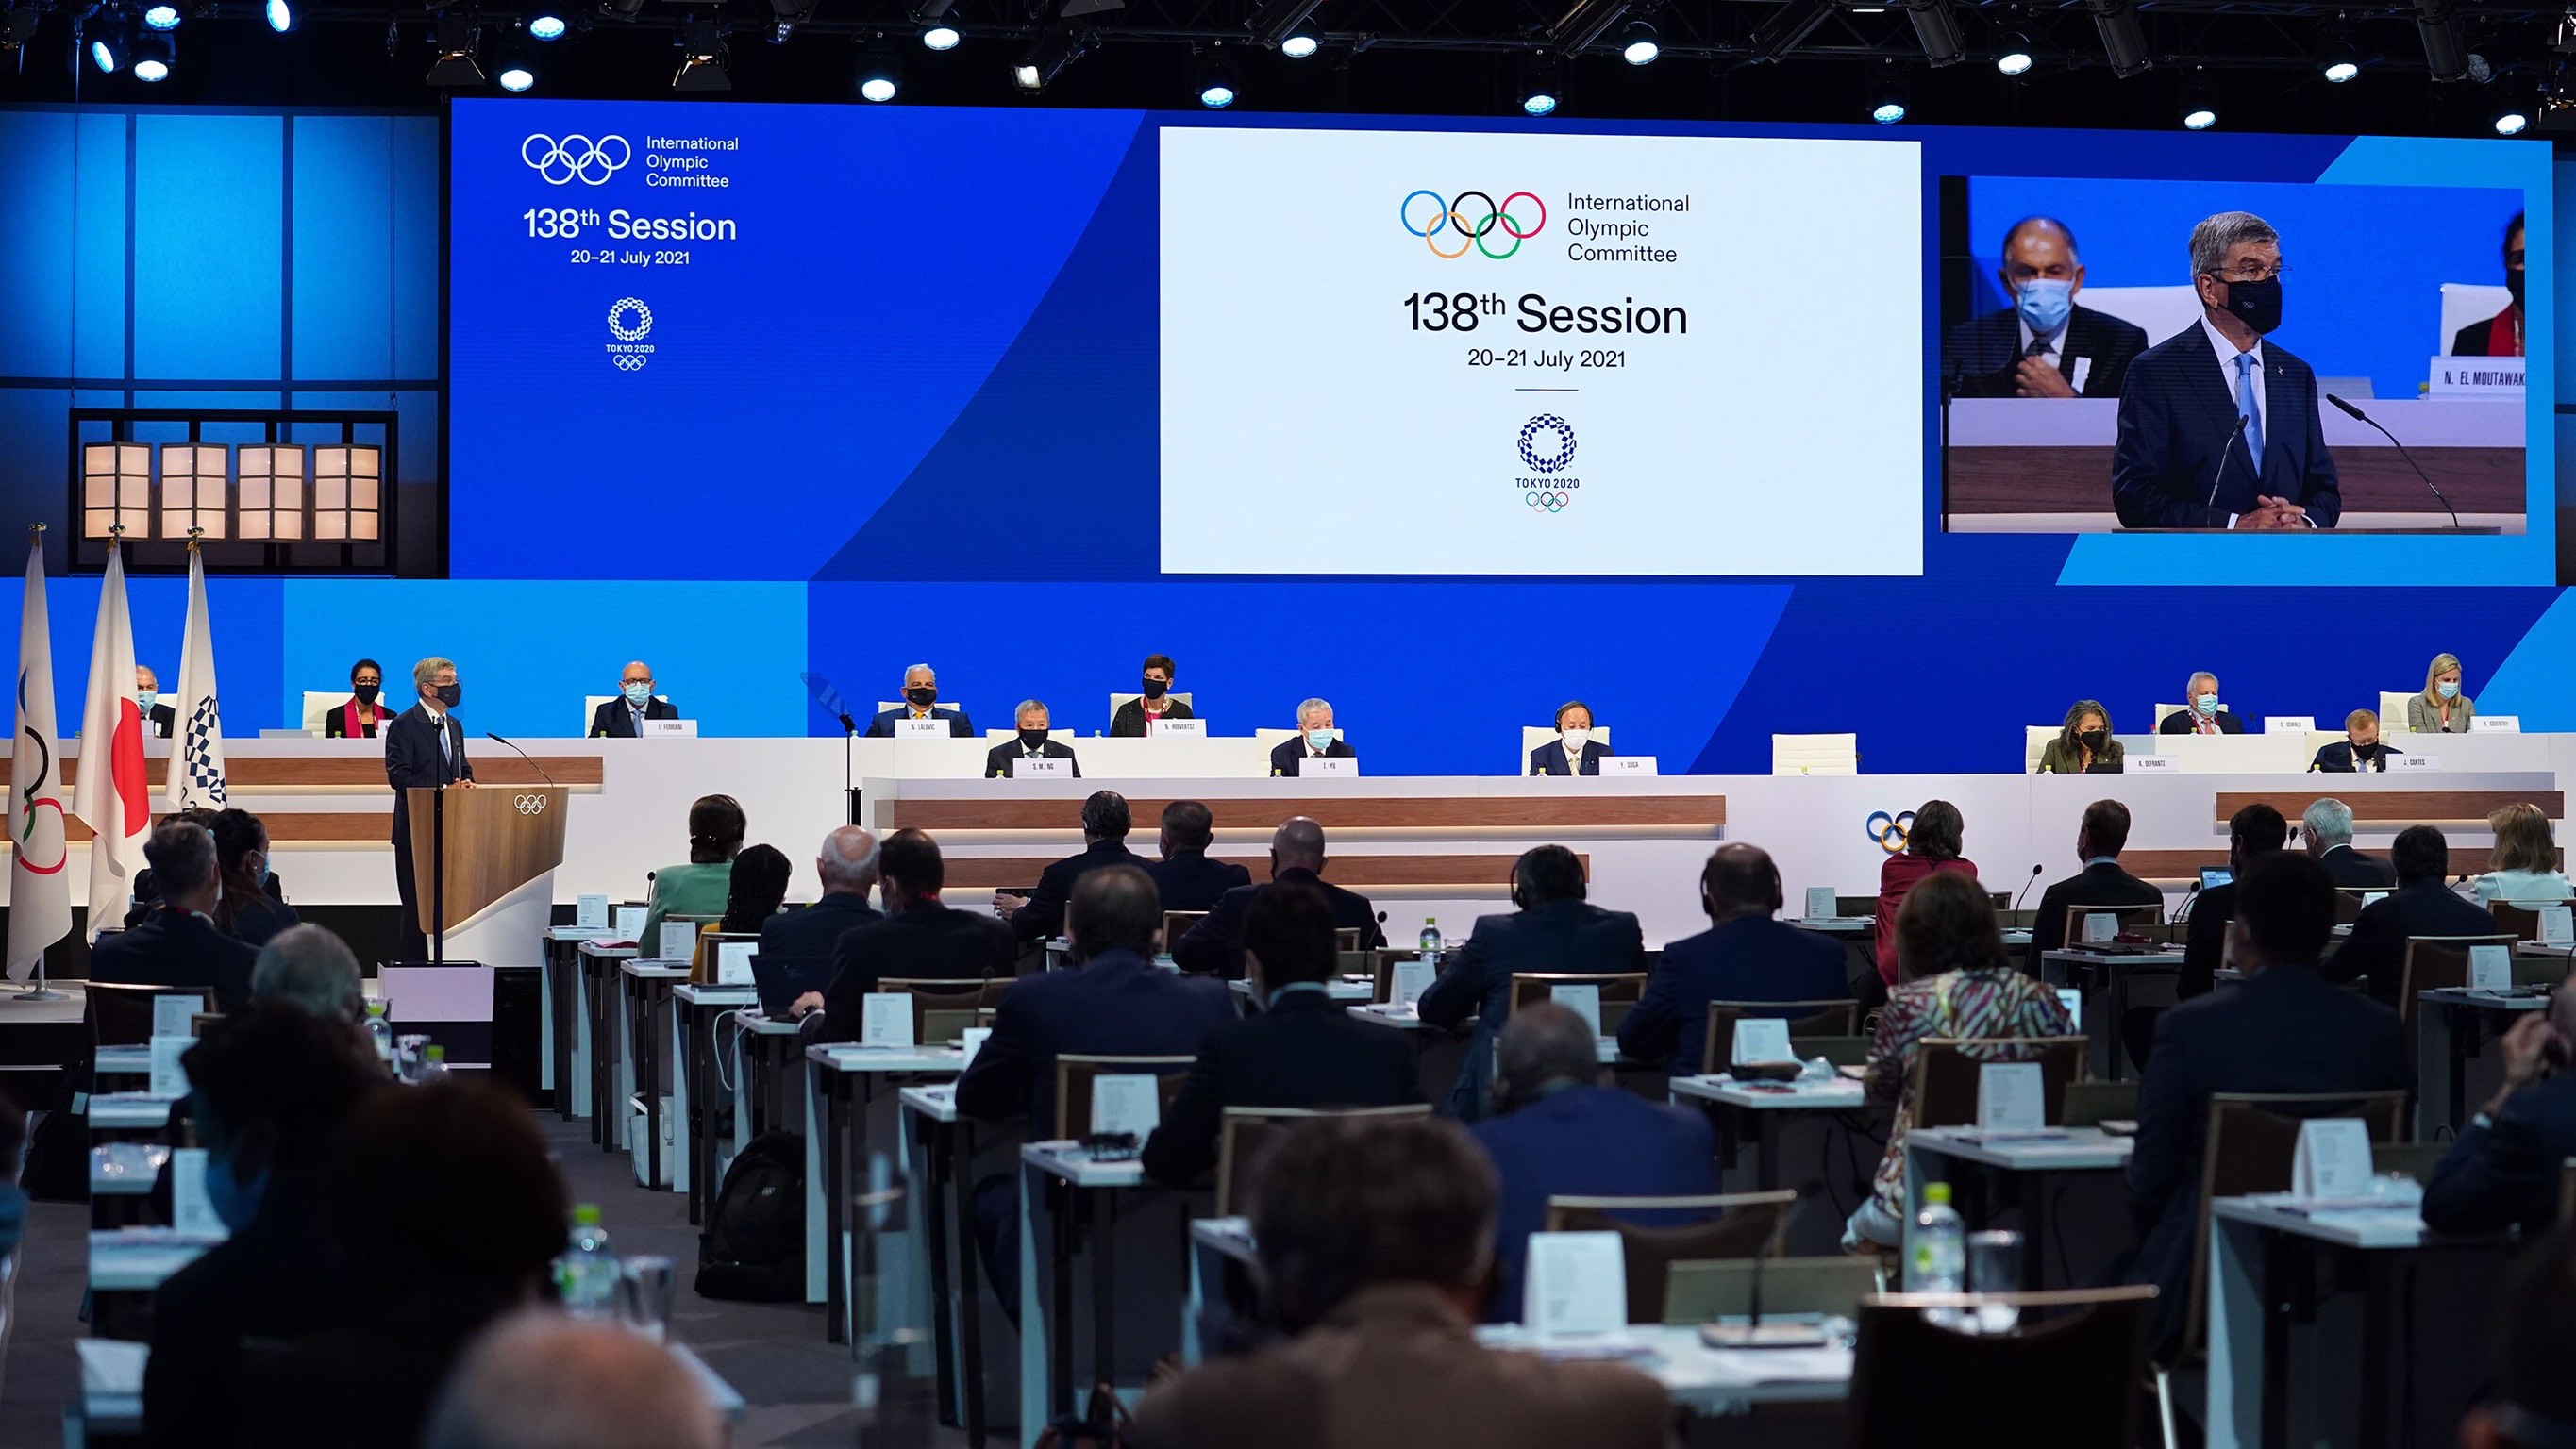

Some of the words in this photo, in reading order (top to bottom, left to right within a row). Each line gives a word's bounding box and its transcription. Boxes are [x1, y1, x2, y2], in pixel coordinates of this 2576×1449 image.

[646, 136, 738, 151] International
[646, 155, 709, 172] Olympic
[646, 173, 729, 188] Committee
[1568, 192, 1689, 212] International
[523, 208, 599, 239] 138th
[608, 209, 736, 241] Session
[1567, 218, 1649, 241] Olympic
[620, 251, 651, 267] July
[655, 251, 690, 264] 2021
[1567, 243, 1678, 263] Committee
[1404, 292, 1506, 332] 138th
[1517, 294, 1687, 335] Session
[606, 344, 633, 353] TOKYO
[634, 344, 655, 353] 2020
[1533, 350, 1574, 372] July
[1580, 350, 1625, 368] 2021
[2444, 371, 2454, 385] N.
[2460, 371, 2469, 385] EL
[2473, 372, 2525, 387] MOUTAWAK
[1515, 477, 1551, 489] TOKYO
[1553, 478, 1580, 489] 2020
